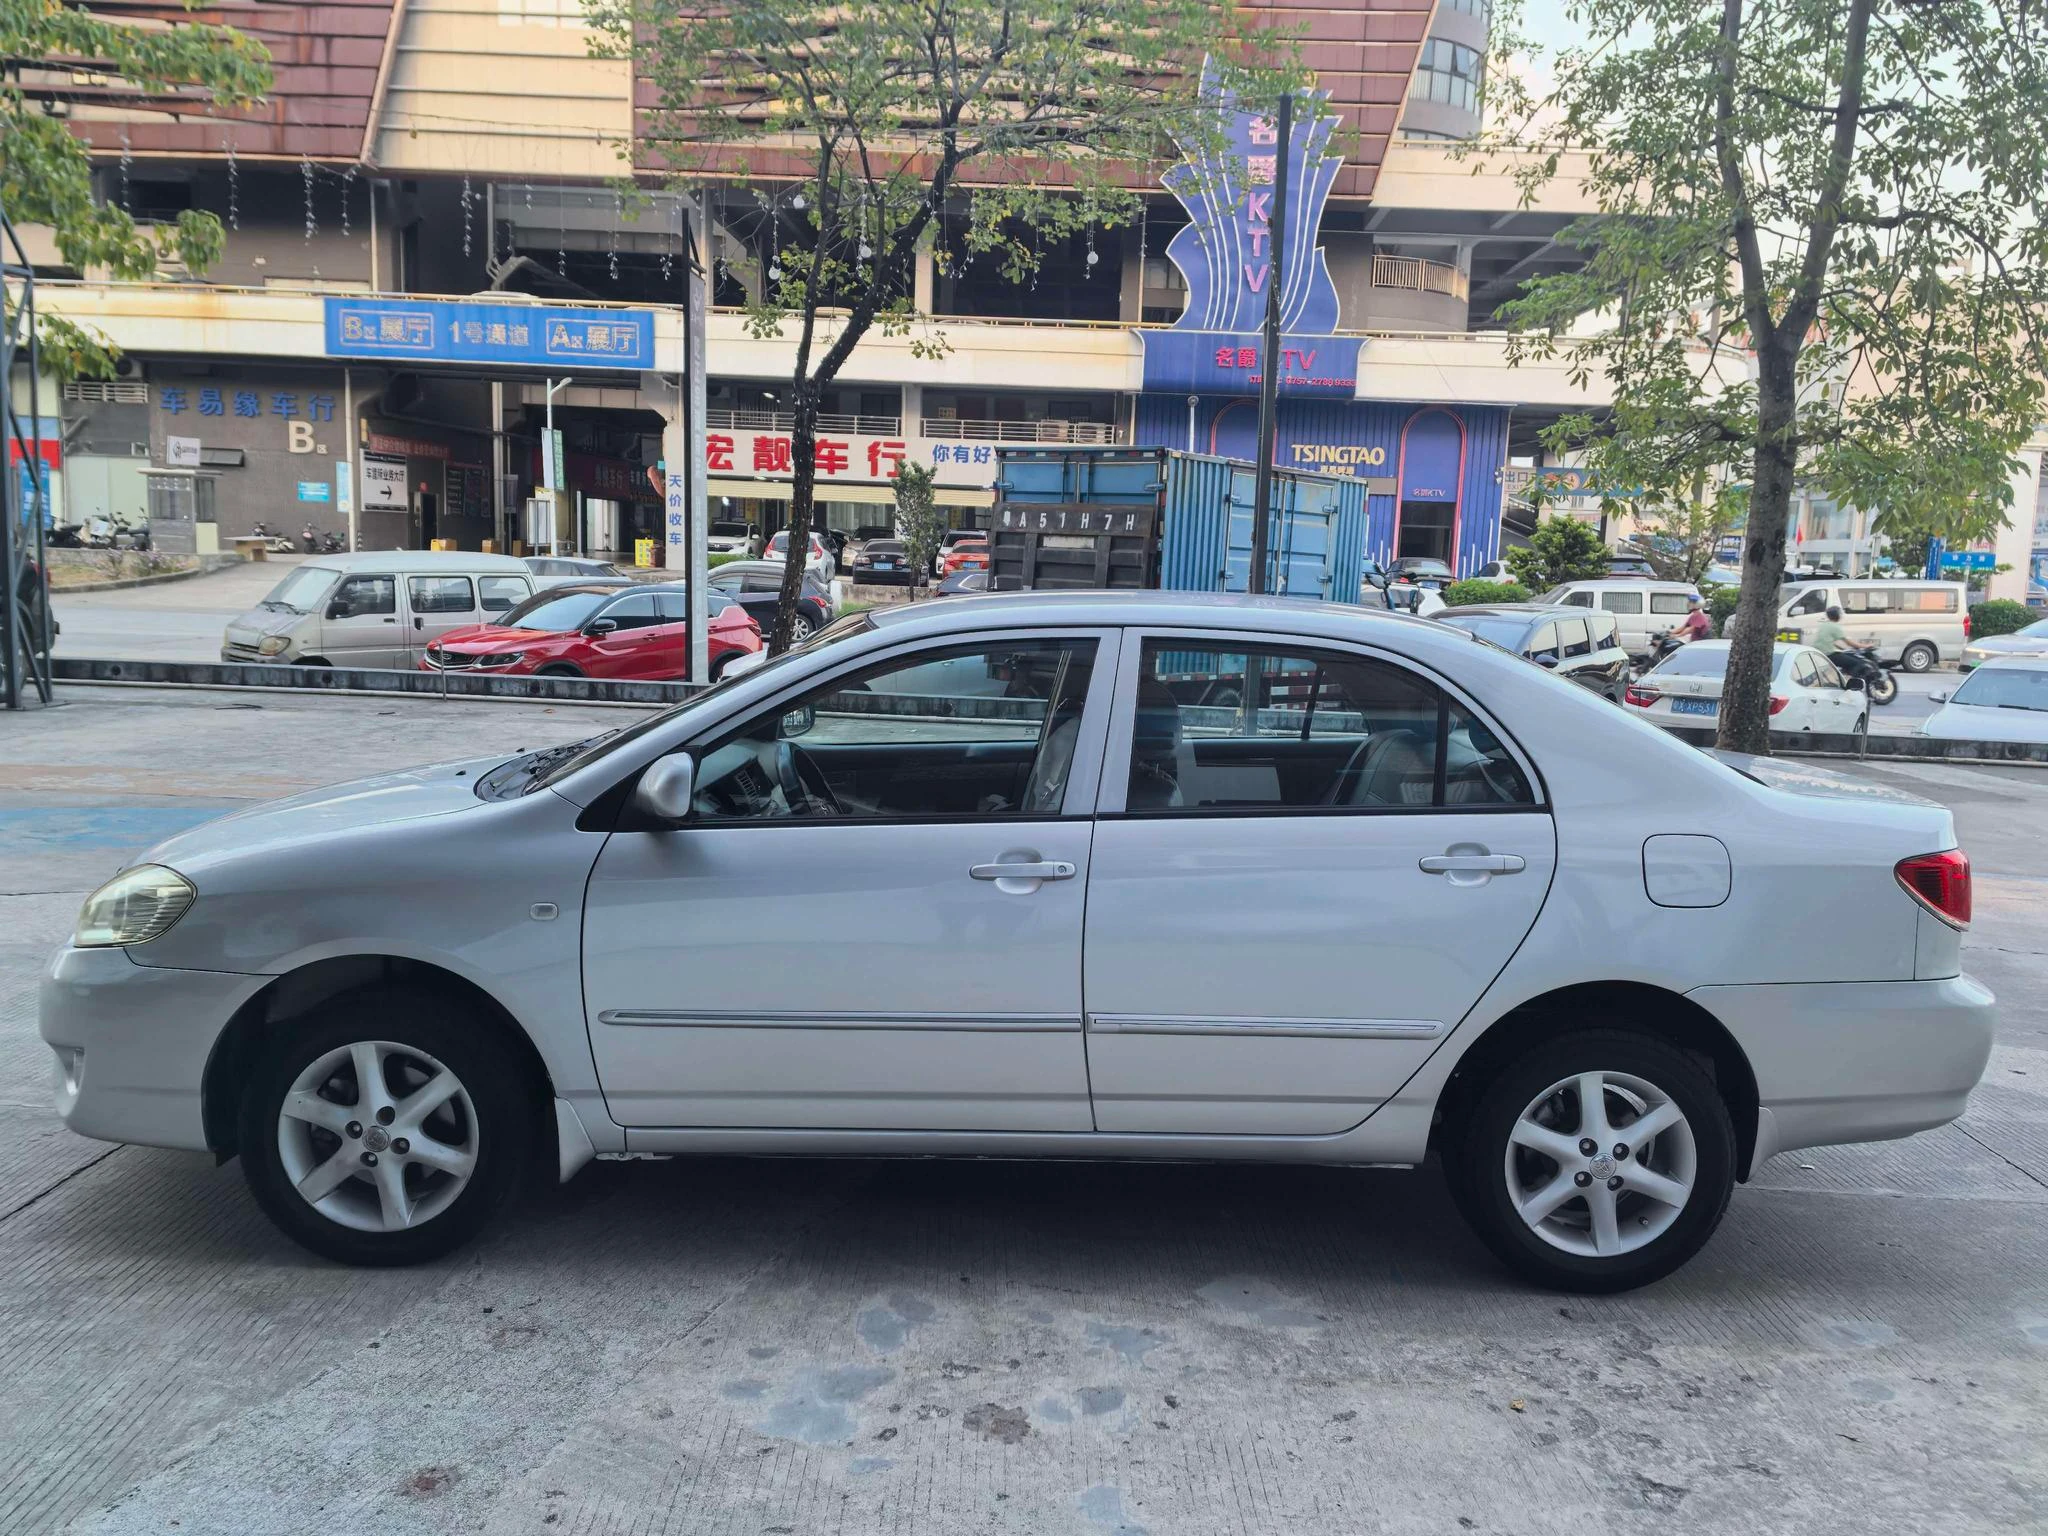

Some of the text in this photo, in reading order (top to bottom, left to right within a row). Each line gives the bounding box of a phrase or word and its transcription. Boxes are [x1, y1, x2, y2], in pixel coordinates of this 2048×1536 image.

[1216, 346, 1316, 370] 名爵TV
[160, 387, 336, 422] 车易缘车行
[1291, 444, 1385, 465] TSINGTAO
[668, 474, 682, 546] 天价收车
